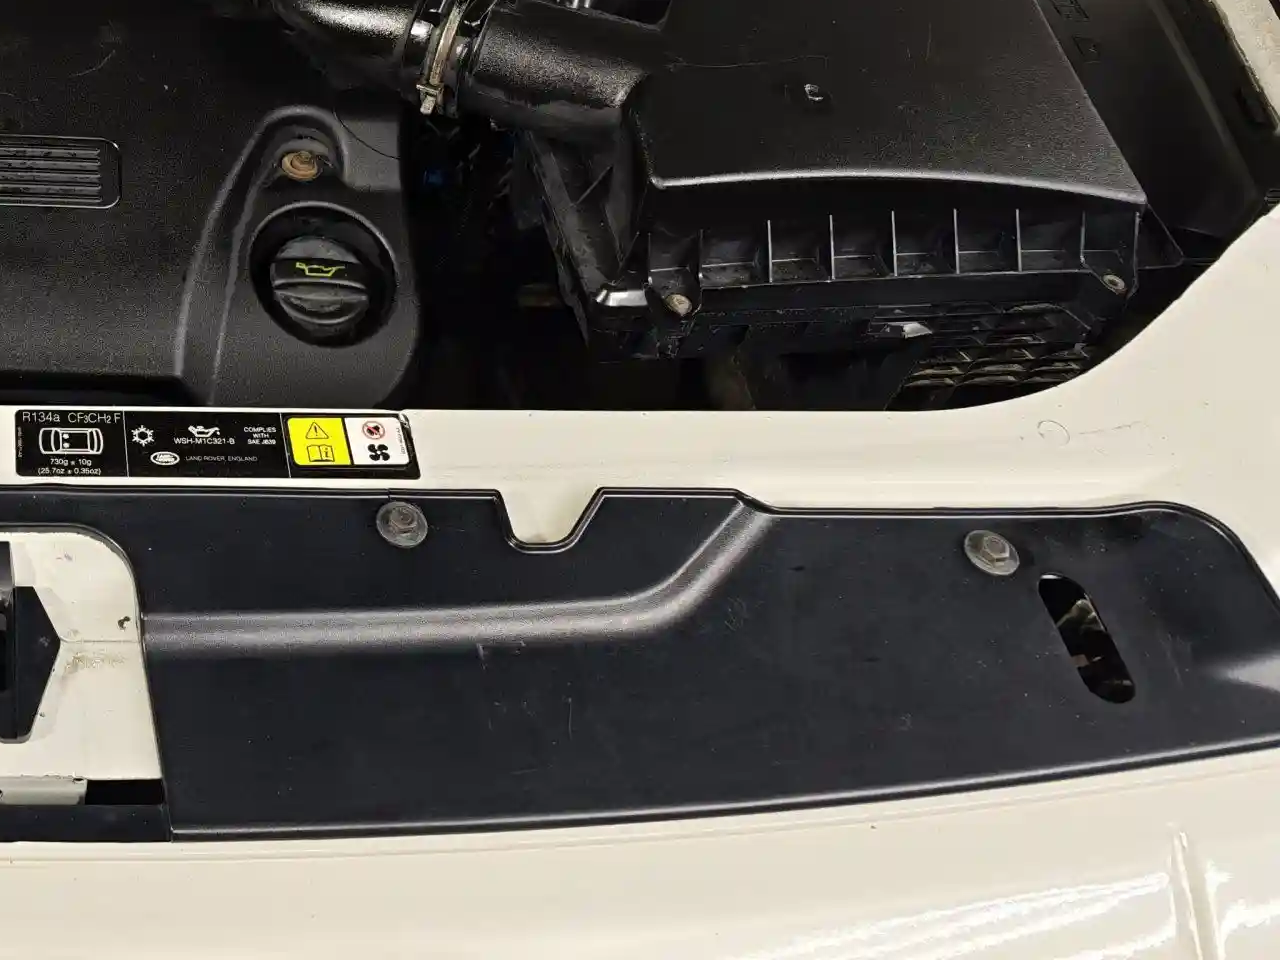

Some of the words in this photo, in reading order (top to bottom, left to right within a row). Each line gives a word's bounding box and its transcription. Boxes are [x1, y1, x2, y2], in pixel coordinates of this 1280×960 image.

[22, 411, 60, 422] R134a
[50, 458, 69, 466] 730g
[78, 458, 92, 467] 10g
